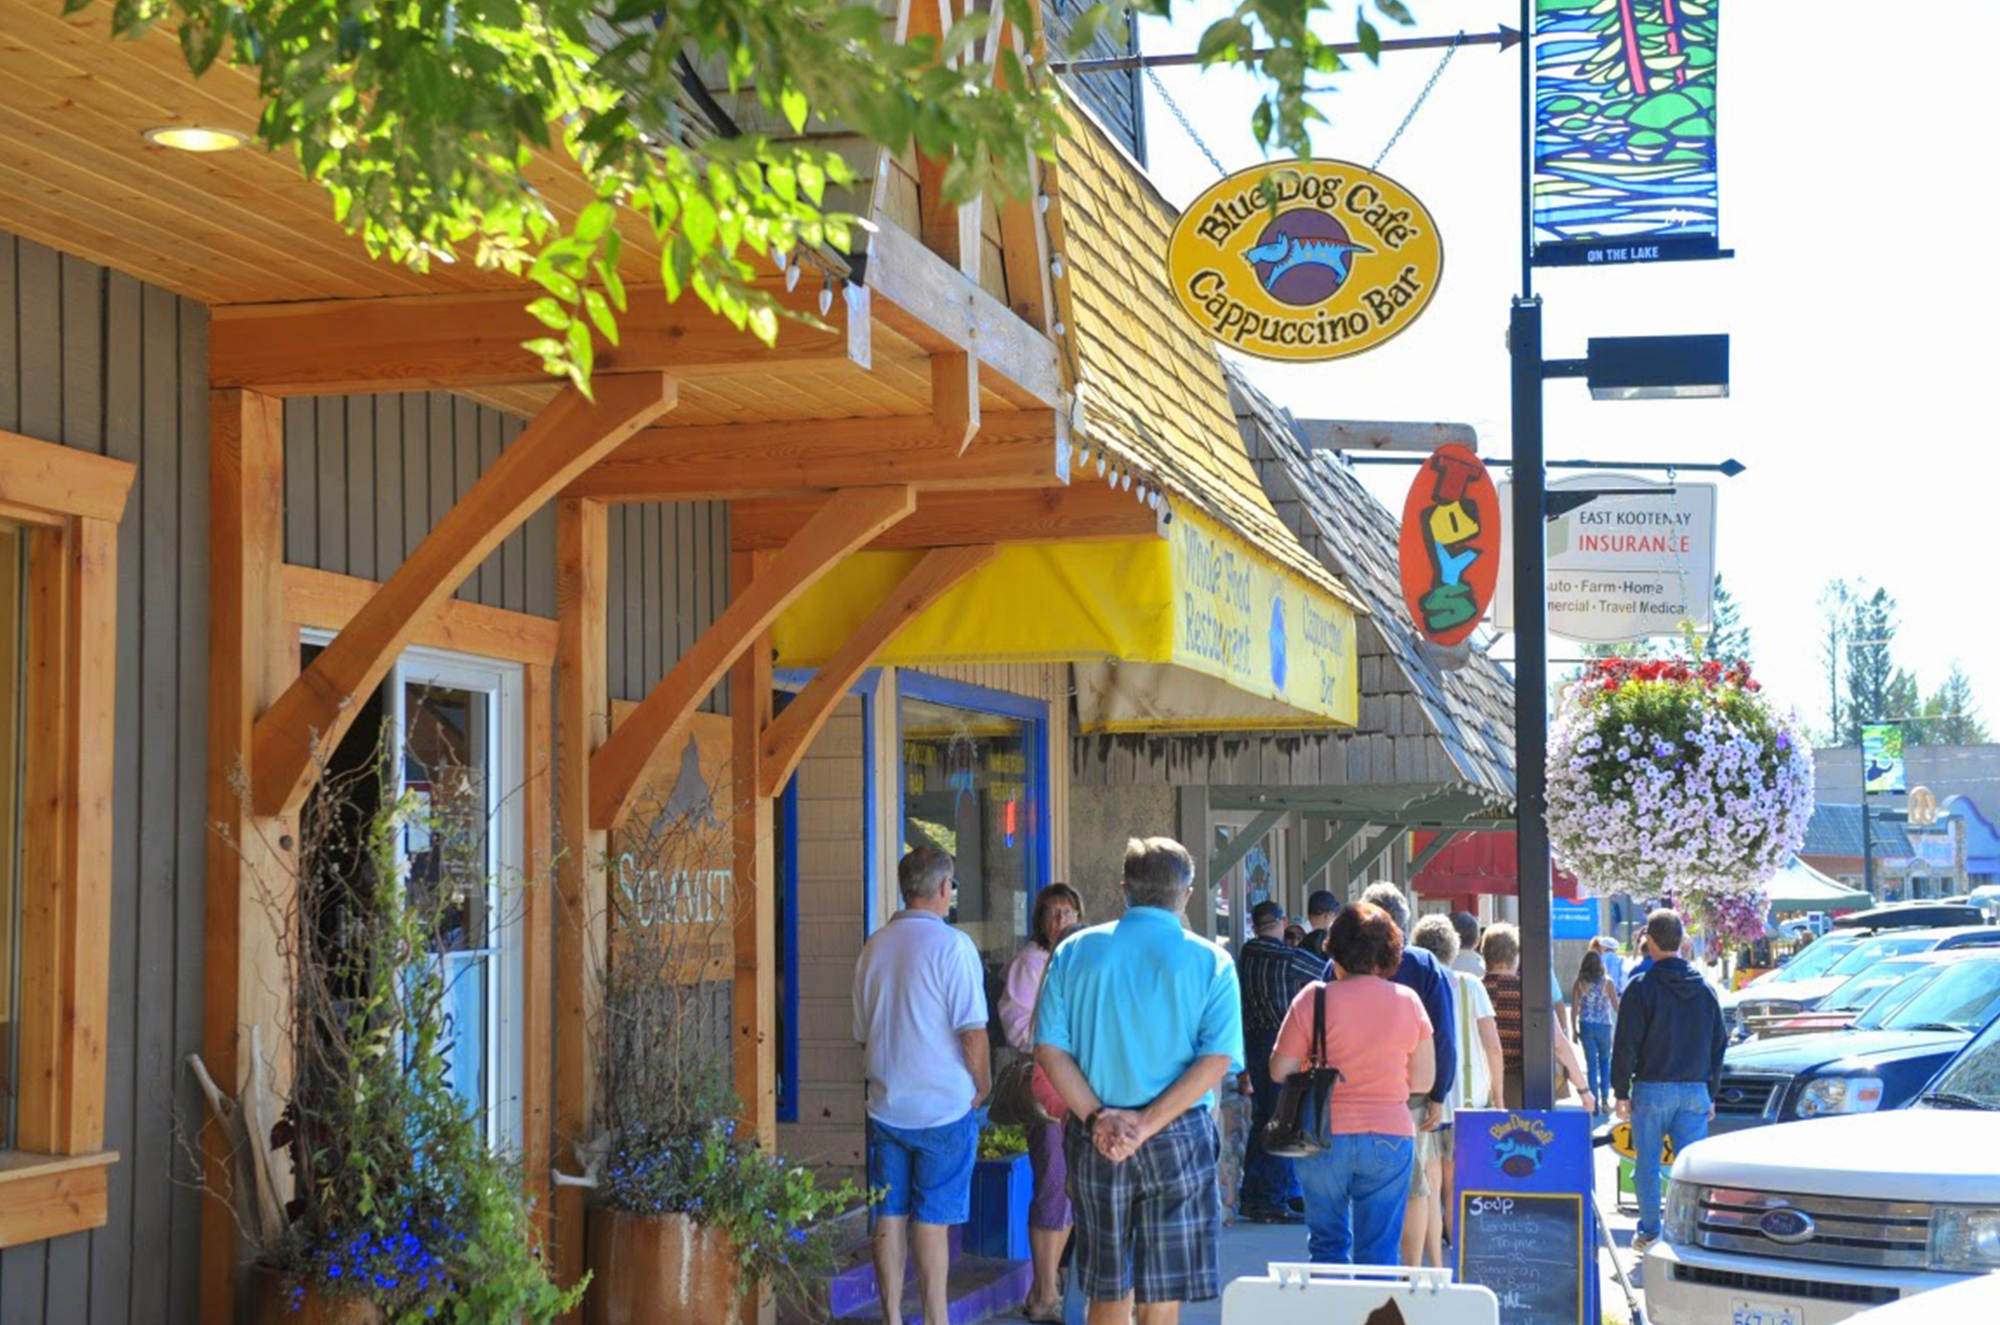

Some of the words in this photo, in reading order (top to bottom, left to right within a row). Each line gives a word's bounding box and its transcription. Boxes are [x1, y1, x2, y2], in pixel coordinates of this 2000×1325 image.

[1198, 185, 1269, 247] Blue
[1274, 170, 1342, 209] Dog
[1345, 183, 1418, 249] Café
[1587, 250, 1603, 262] ON
[1606, 248, 1628, 261] THE
[1631, 246, 1659, 259] LAKE
[1189, 270, 1369, 346] Cappuccino
[1362, 266, 1421, 326] Bar
[1579, 511, 1612, 525] EAST
[1617, 511, 1691, 526] KOOTENAY
[1579, 534, 1690, 553] INSURANCE
[1581, 580, 1616, 593] Farm
[1599, 600, 1636, 613] Travel
[1640, 601, 1688, 615] Medica
